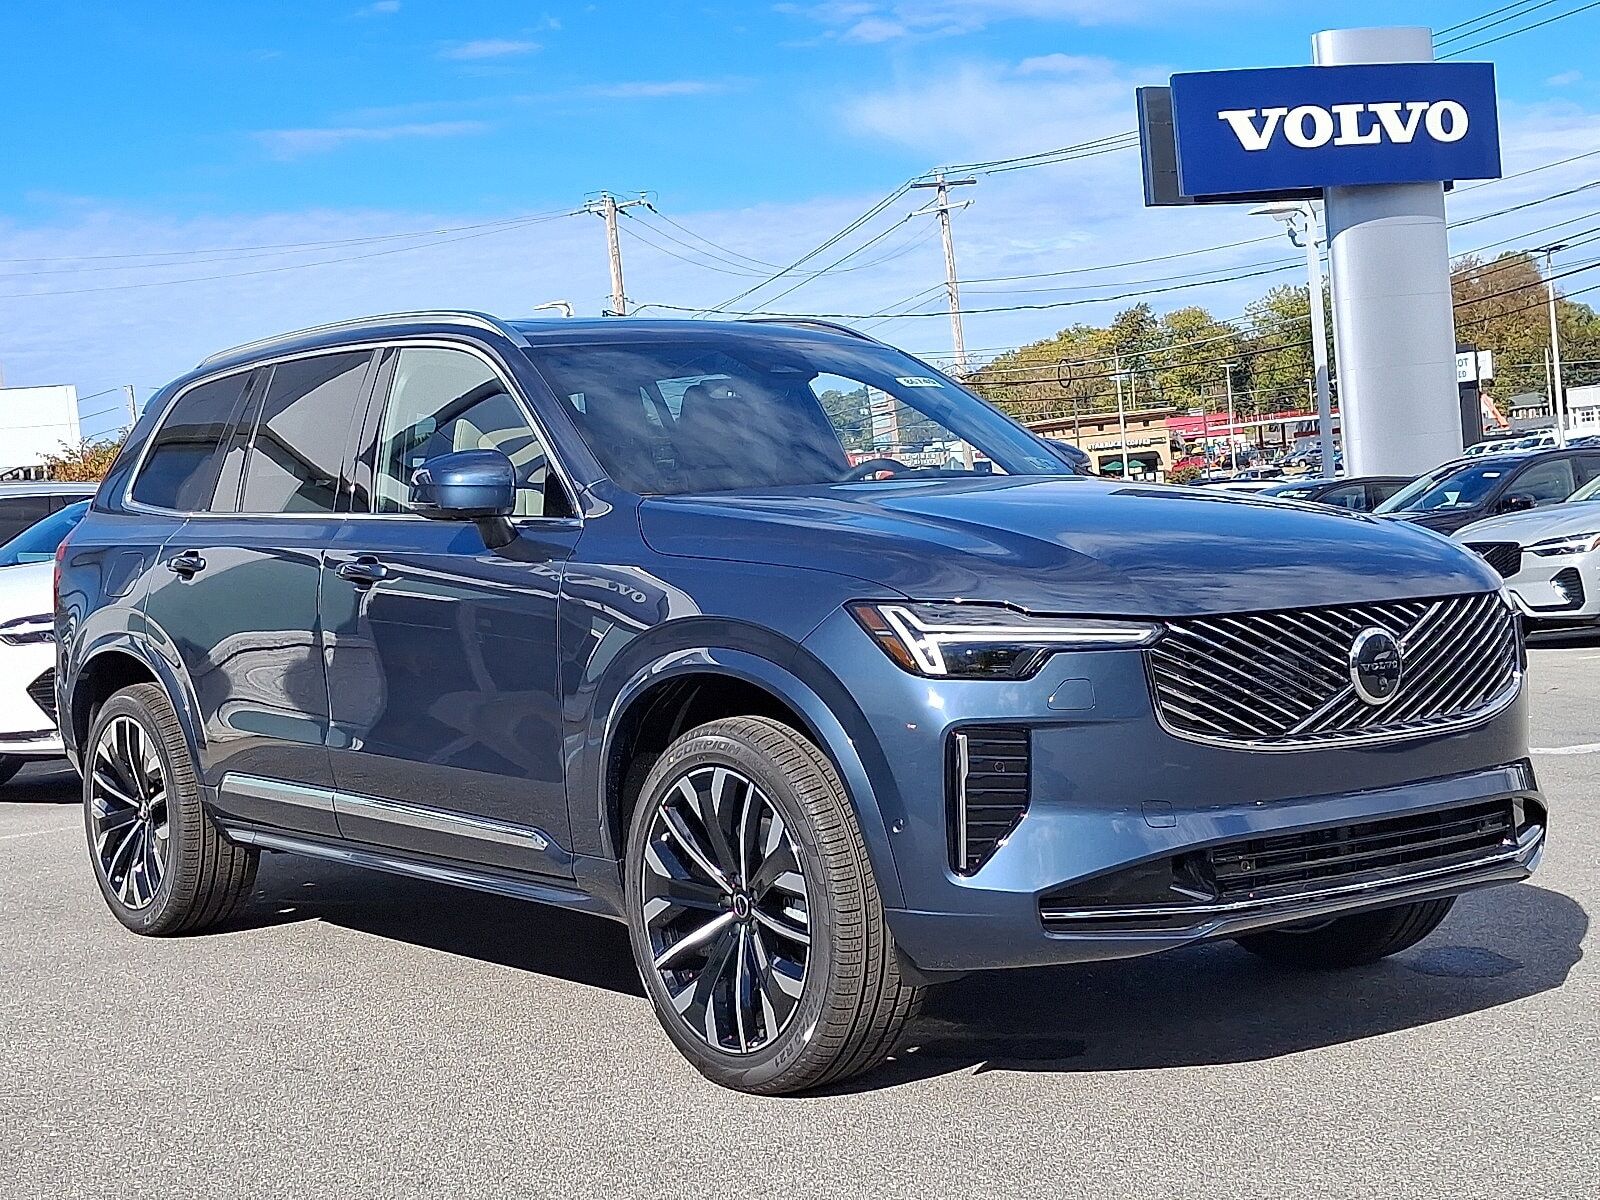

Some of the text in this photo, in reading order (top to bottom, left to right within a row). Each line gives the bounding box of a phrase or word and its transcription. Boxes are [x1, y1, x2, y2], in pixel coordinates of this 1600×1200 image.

[1217, 100, 1469, 151] VOLVO
[1360, 661, 1398, 672] VOLVO
[666, 740, 741, 767] SCORPION
